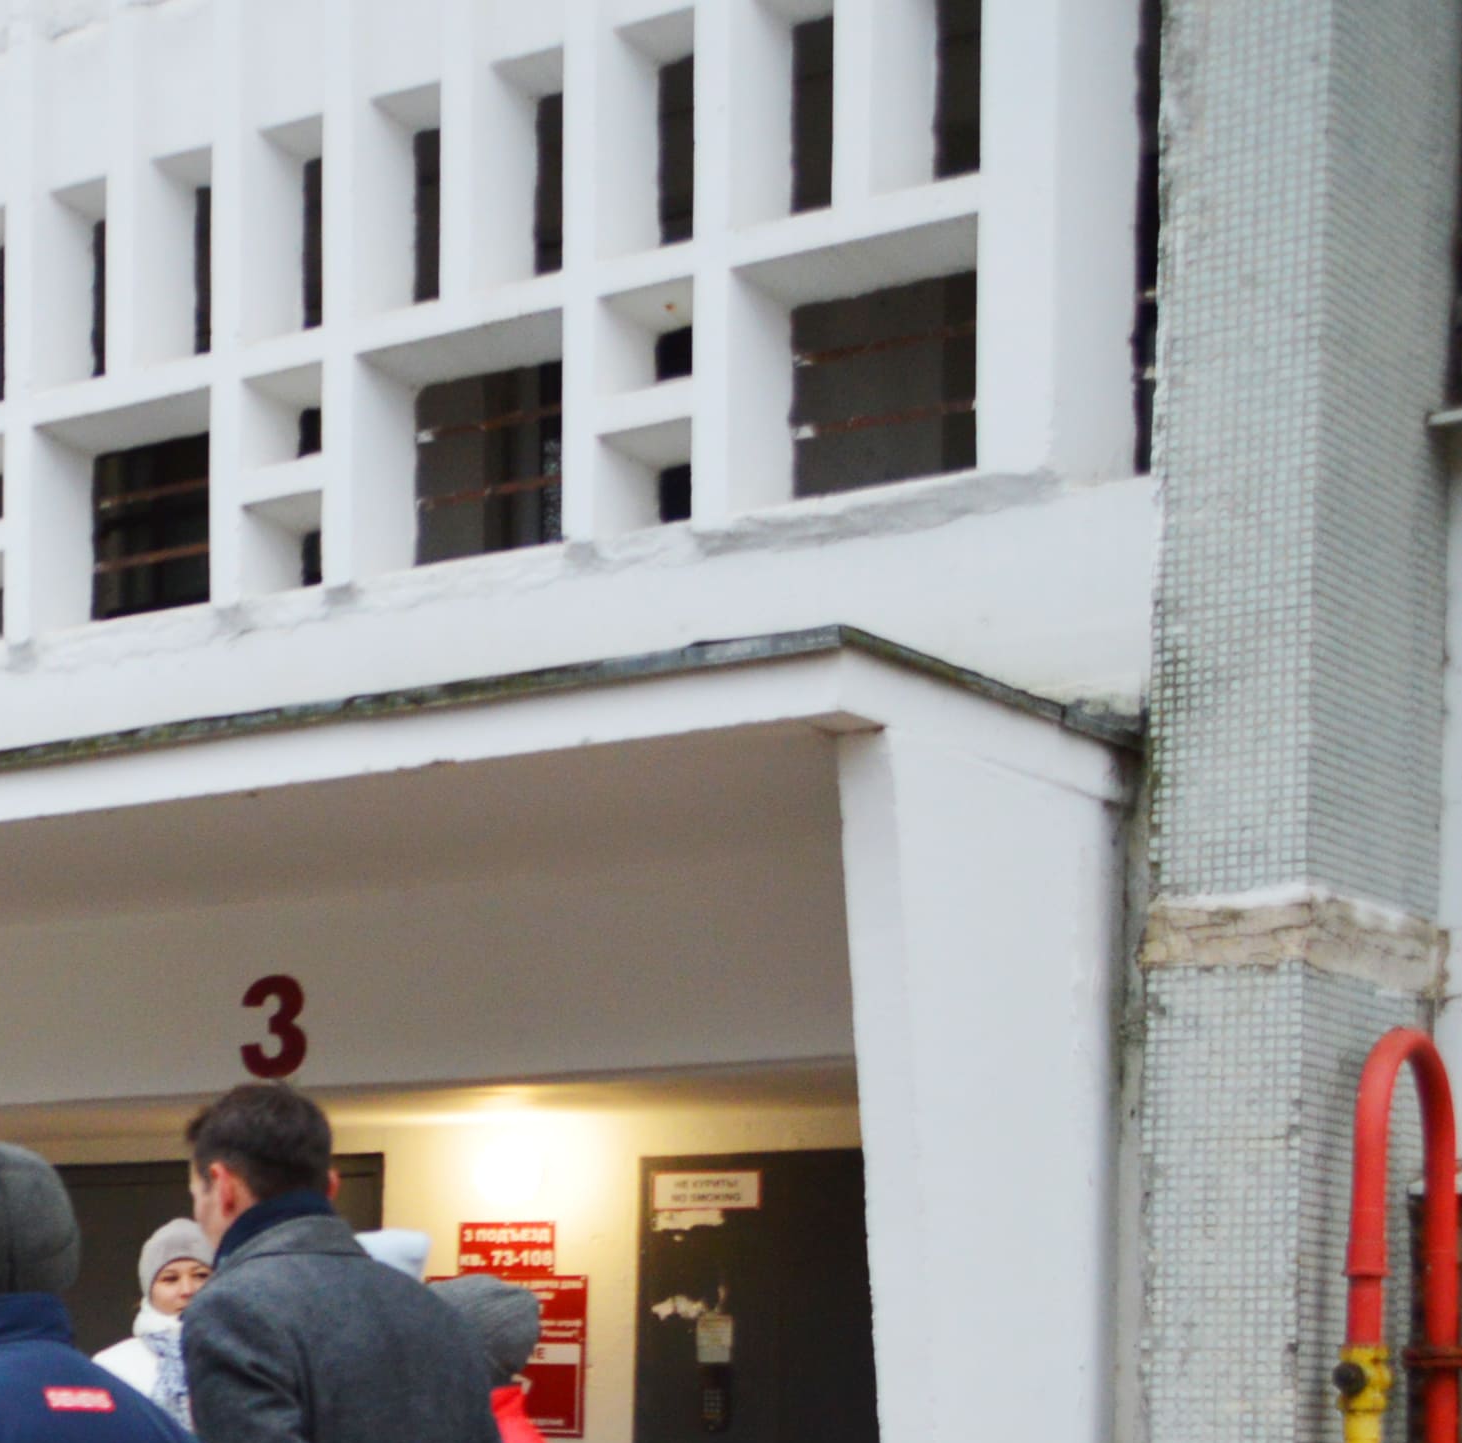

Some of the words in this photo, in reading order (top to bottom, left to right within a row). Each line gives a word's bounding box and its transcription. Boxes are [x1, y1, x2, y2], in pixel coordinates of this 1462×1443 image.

[240, 974, 307, 1079] 3
[463, 1228, 473, 1242] 3
[475, 1227, 551, 1244] ПОДЪЕЗД
[490, 1249, 553, 1266] 73-108
